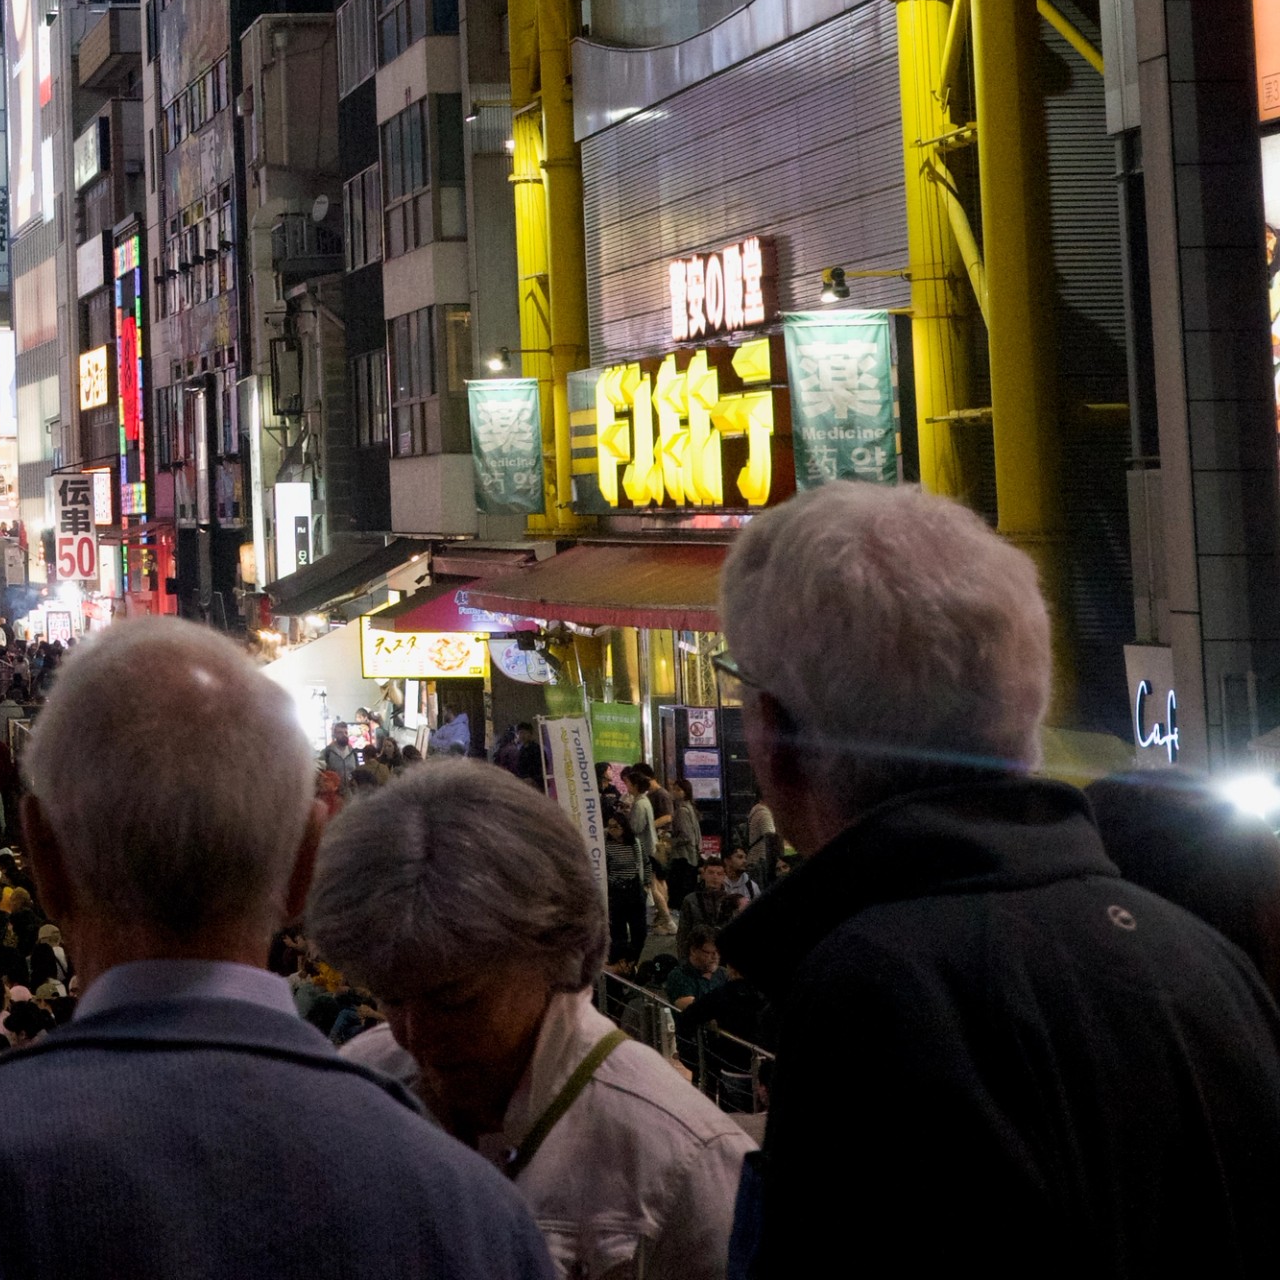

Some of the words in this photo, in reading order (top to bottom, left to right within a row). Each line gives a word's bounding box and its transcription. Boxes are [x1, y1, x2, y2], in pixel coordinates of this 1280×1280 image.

[797, 339, 881, 418] 薬
[475, 399, 533, 455] 薬
[801, 425, 886, 442] Medicine
[483, 456, 537, 469] edicine
[851, 445, 887, 482] 약
[58, 479, 91, 536] 伝串
[58, 537, 96, 579] 50
[570, 726, 591, 790] Tombori
[584, 797, 599, 843] River
